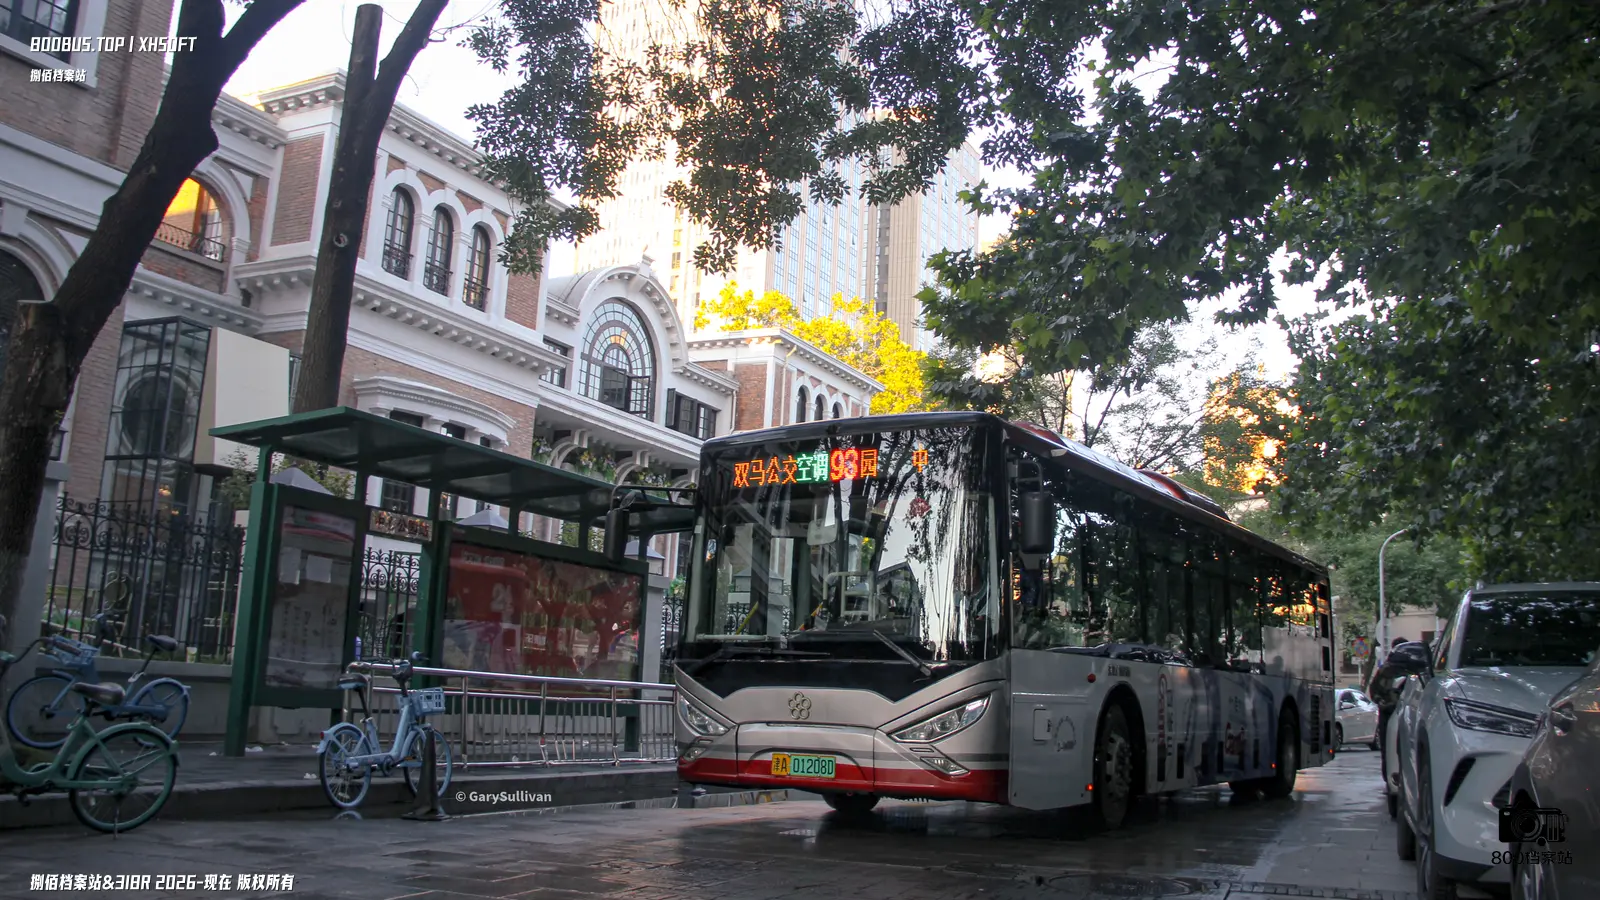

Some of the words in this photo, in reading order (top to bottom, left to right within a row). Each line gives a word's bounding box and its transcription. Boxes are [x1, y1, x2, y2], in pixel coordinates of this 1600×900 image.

[734, 456, 796, 487] 双马公交
[796, 453, 829, 482] 空调
[860, 449, 878, 478] 园
[912, 443, 929, 473] 中
